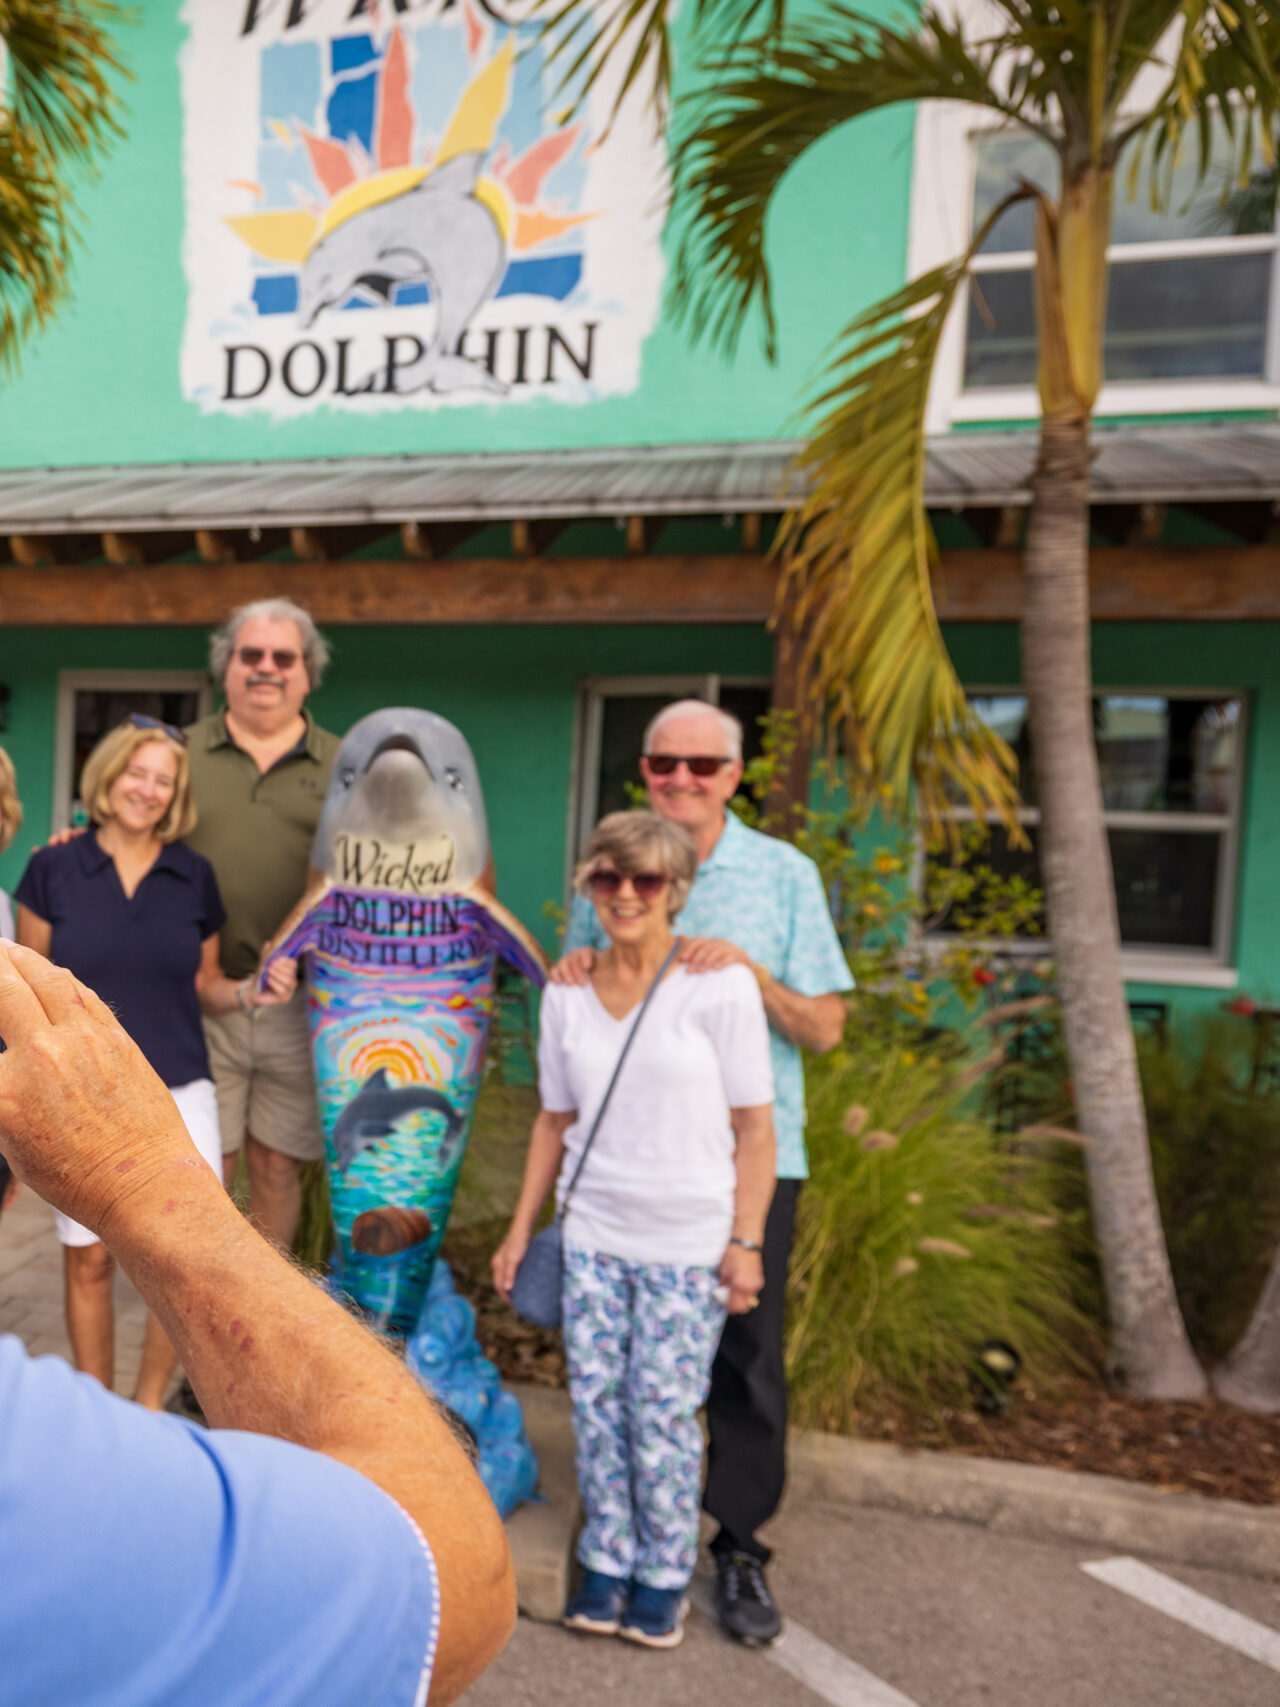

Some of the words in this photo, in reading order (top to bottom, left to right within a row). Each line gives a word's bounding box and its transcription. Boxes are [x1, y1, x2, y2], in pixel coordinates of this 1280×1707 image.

[222, 321, 600, 401] DOLPHIN
[336, 834, 456, 893] Wicked
[333, 891, 463, 936] DOLPHIN
